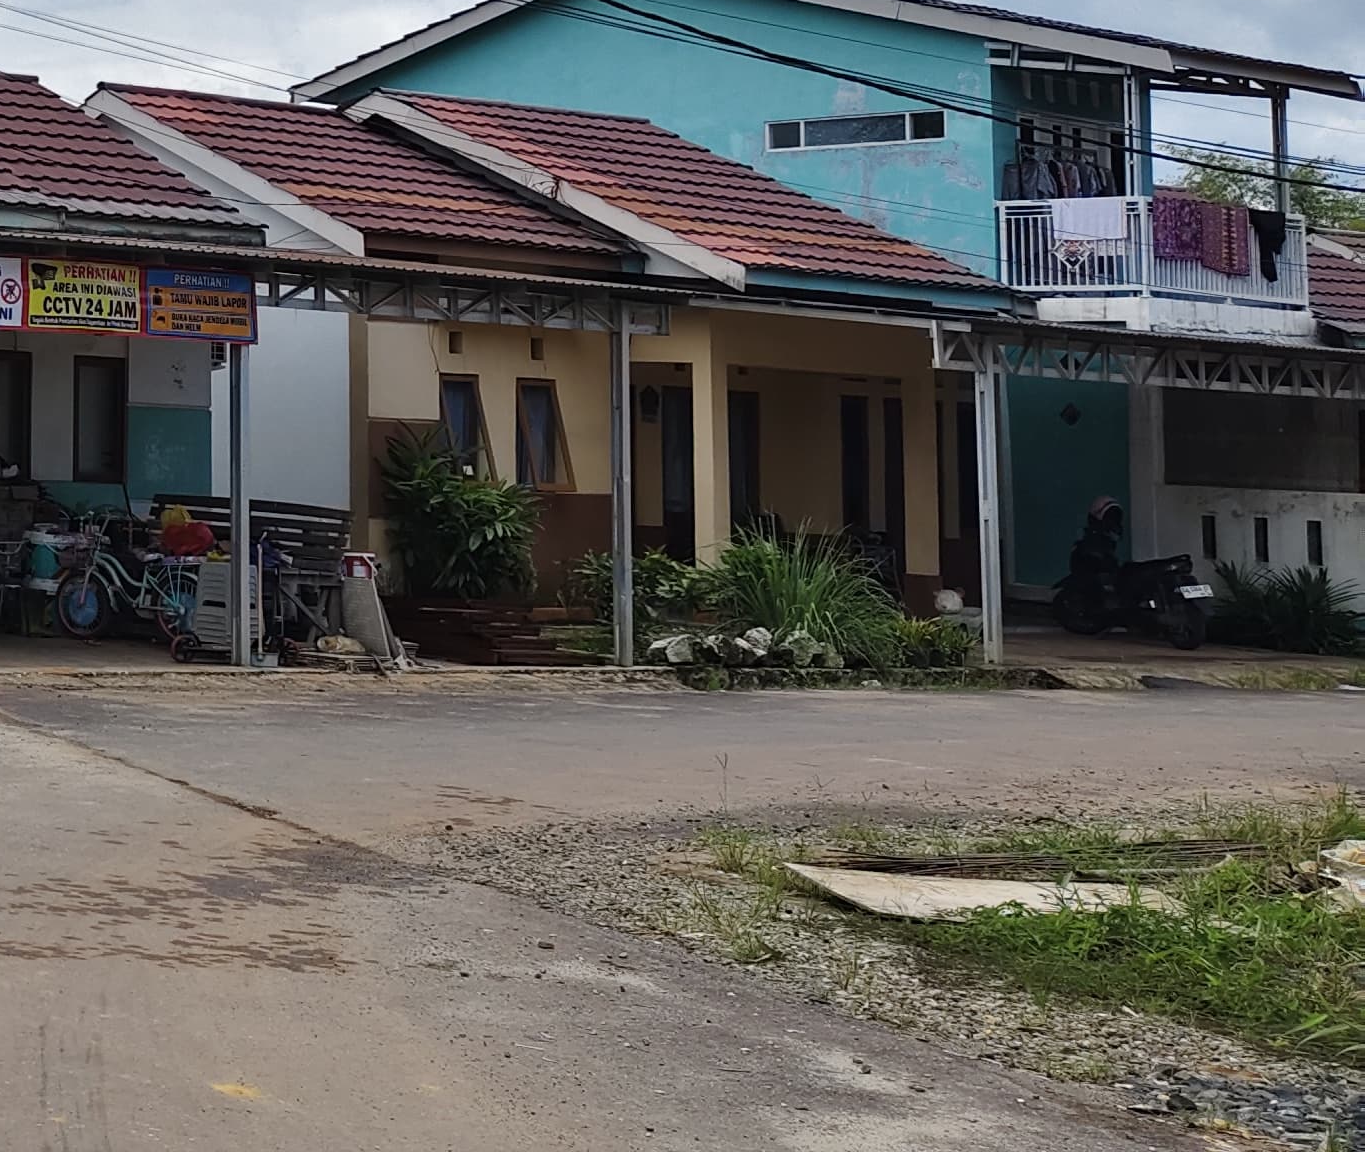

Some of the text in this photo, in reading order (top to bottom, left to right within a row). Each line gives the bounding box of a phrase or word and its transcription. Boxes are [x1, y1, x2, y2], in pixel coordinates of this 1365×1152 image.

[64, 265, 126, 282] PERHATIAN
[173, 273, 222, 288] PERHATIAN
[52, 282, 136, 298] AREA INI DIAWASI
[43, 295, 137, 319] CCTV 24 JAM
[170, 292, 247, 309] TAMU WAJIB LAPOR
